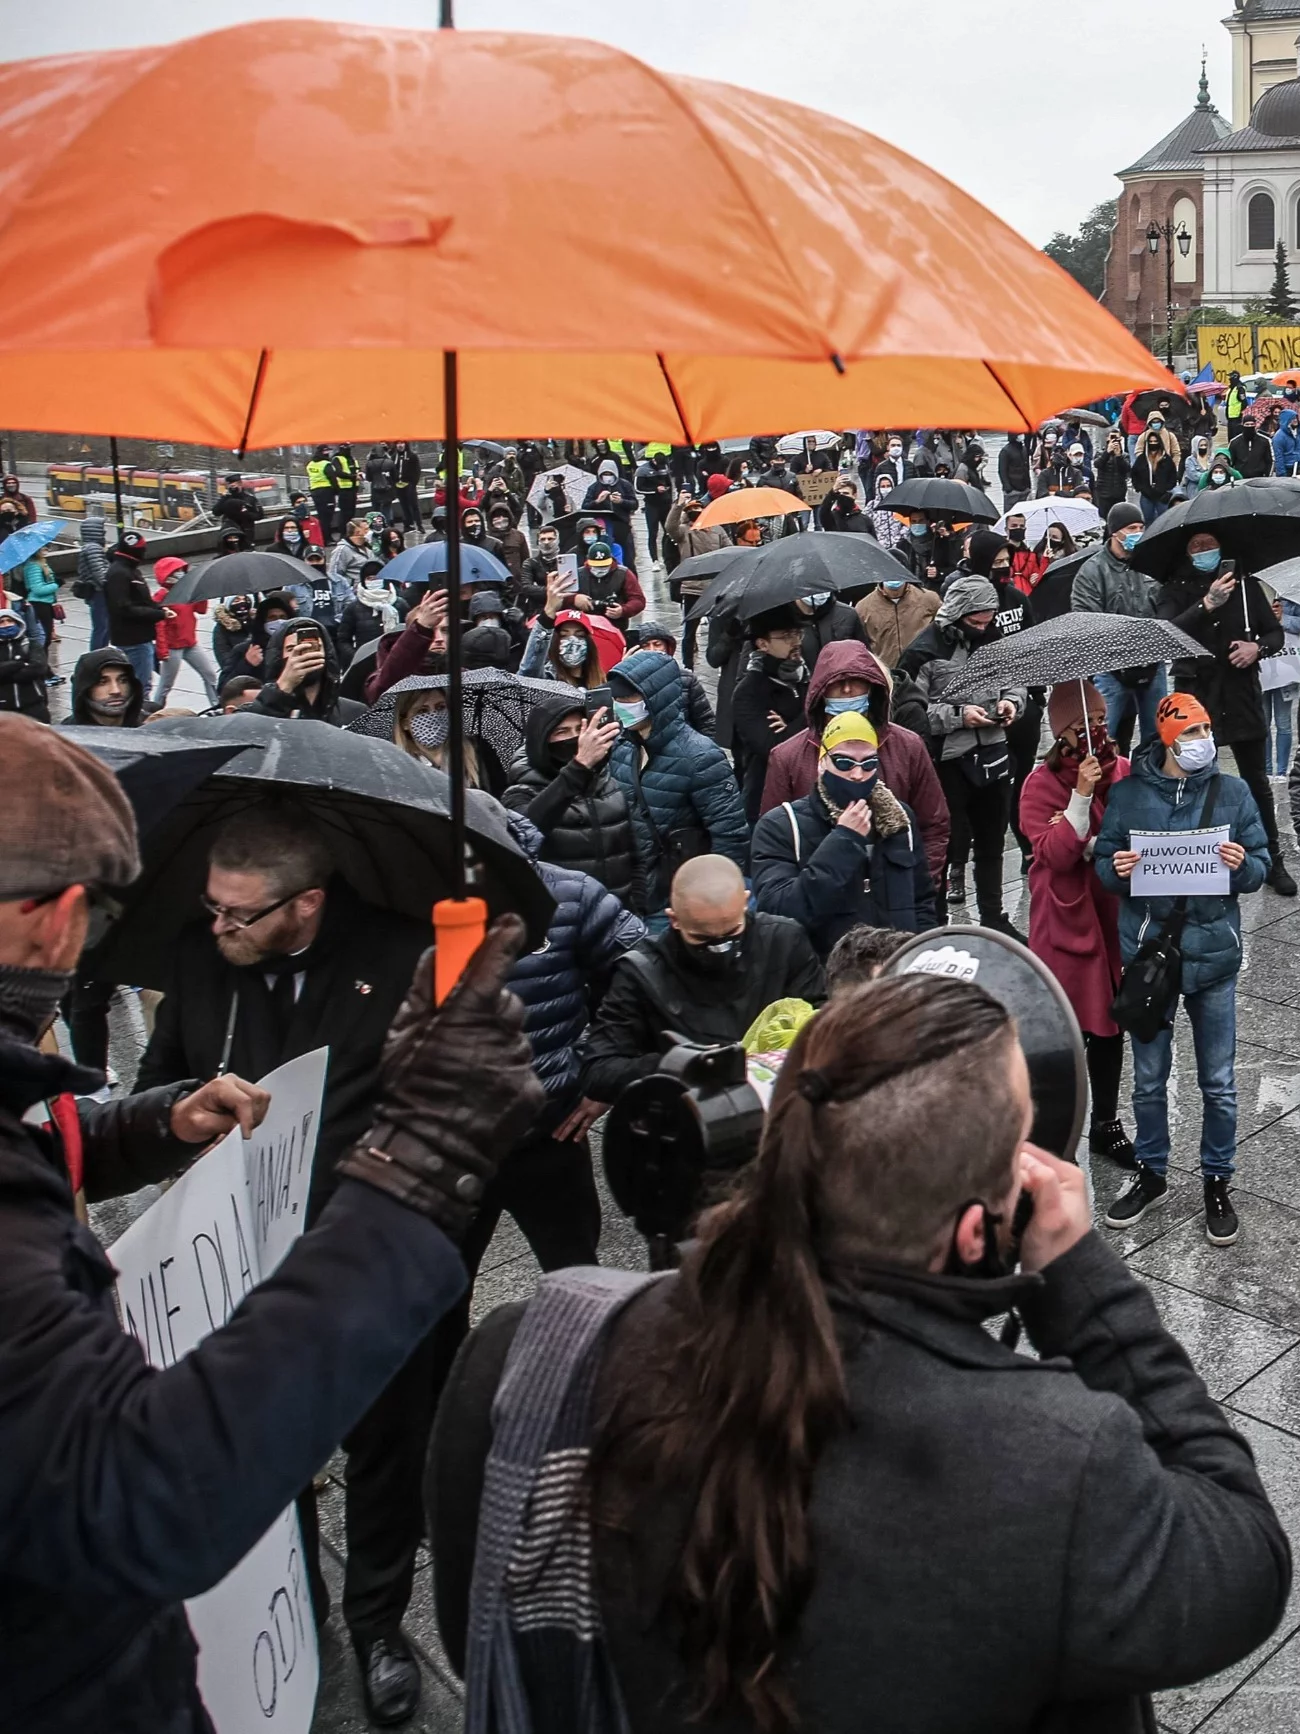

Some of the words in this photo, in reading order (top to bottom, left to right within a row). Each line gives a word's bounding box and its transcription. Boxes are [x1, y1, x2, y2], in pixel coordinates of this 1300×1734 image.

[1289, 647, 1297, 656] IS
[1140, 841, 1220, 858] #UWOLNIĆ
[1143, 862, 1218, 875] PŁYWANIE
